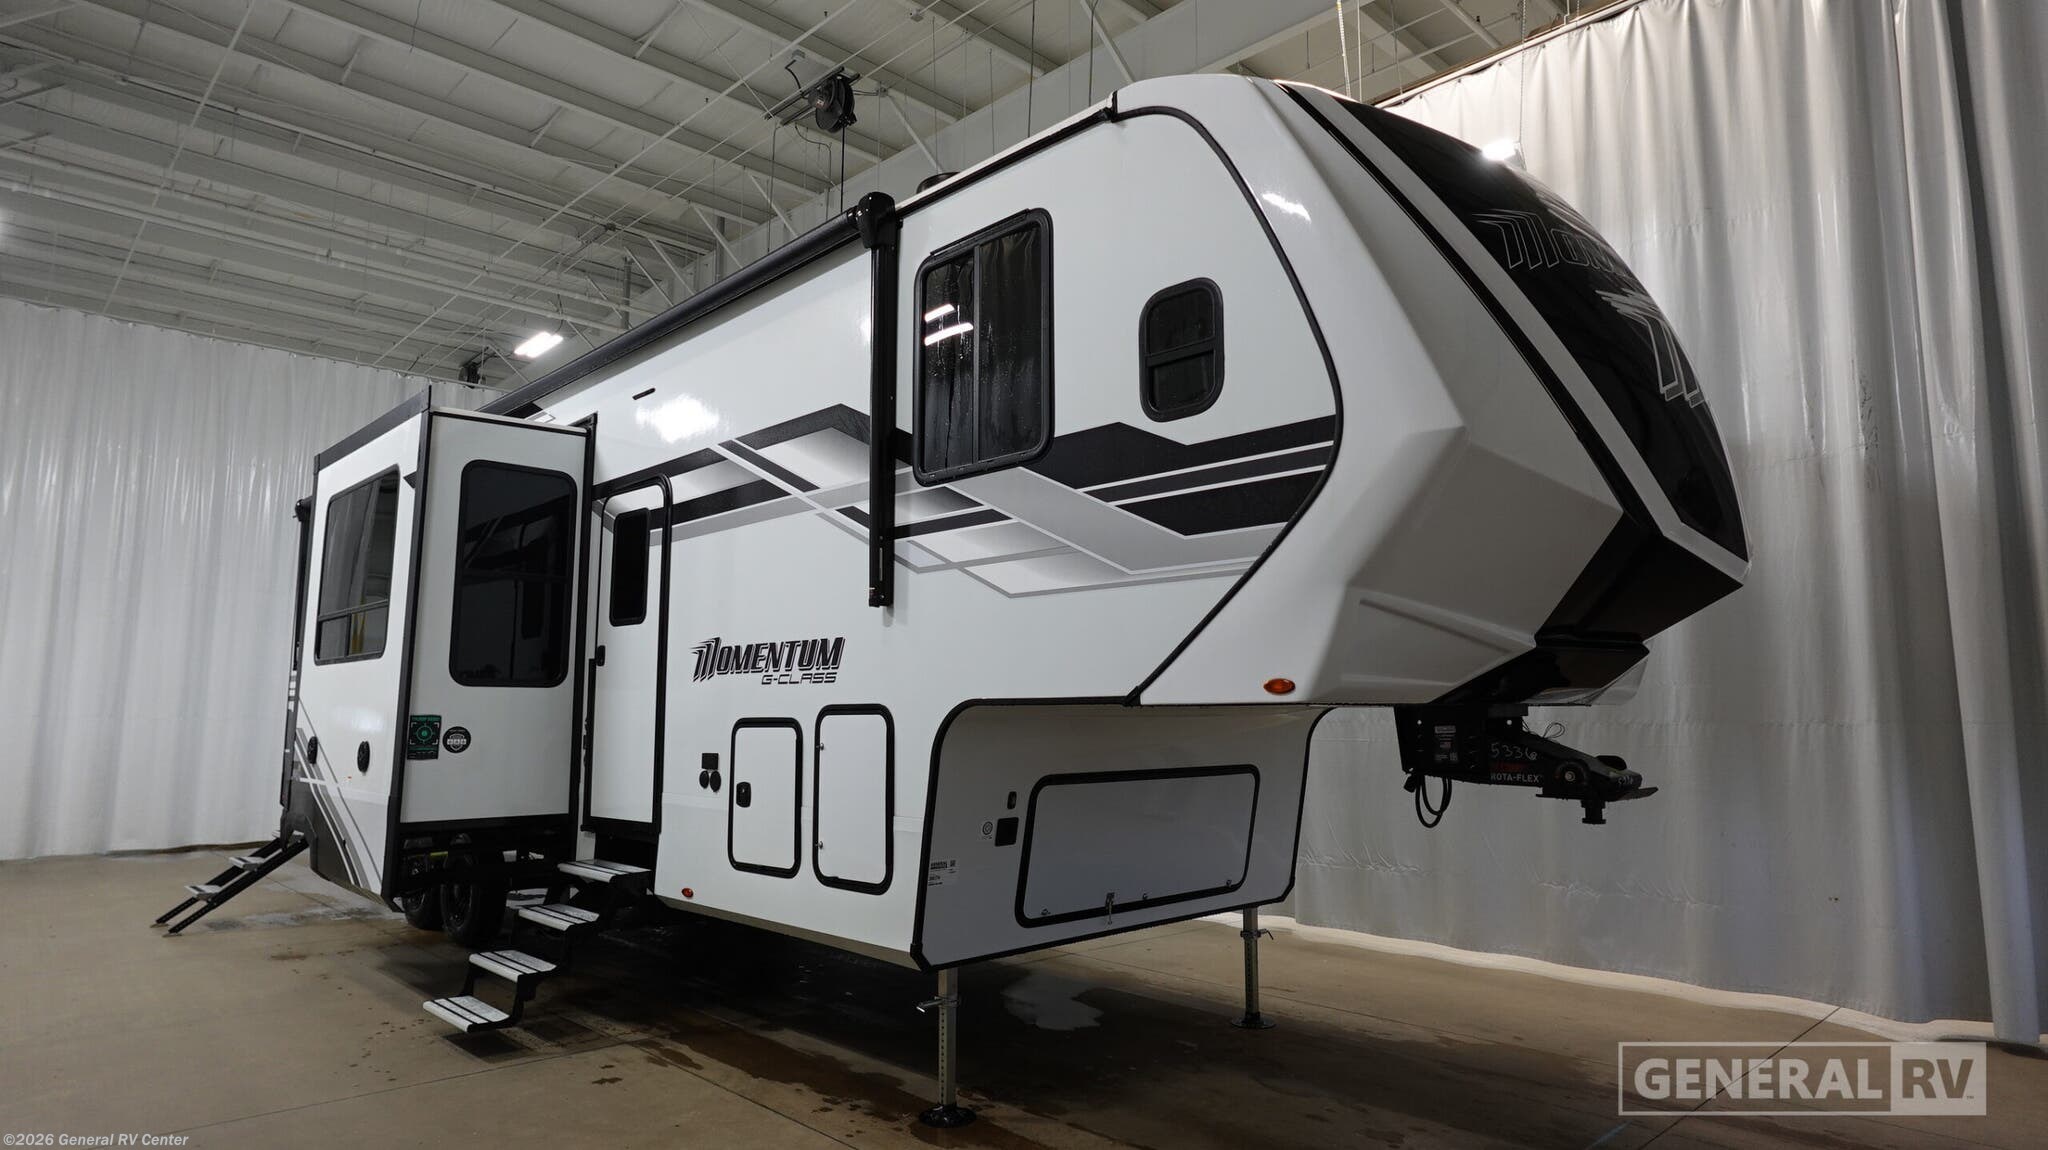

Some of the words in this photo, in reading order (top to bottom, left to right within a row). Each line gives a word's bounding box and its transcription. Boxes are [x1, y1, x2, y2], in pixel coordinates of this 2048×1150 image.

[689, 636, 845, 682] MOMENTUM
[761, 671, 837, 686] G-CLASS
[1490, 742, 1538, 761] 5336
